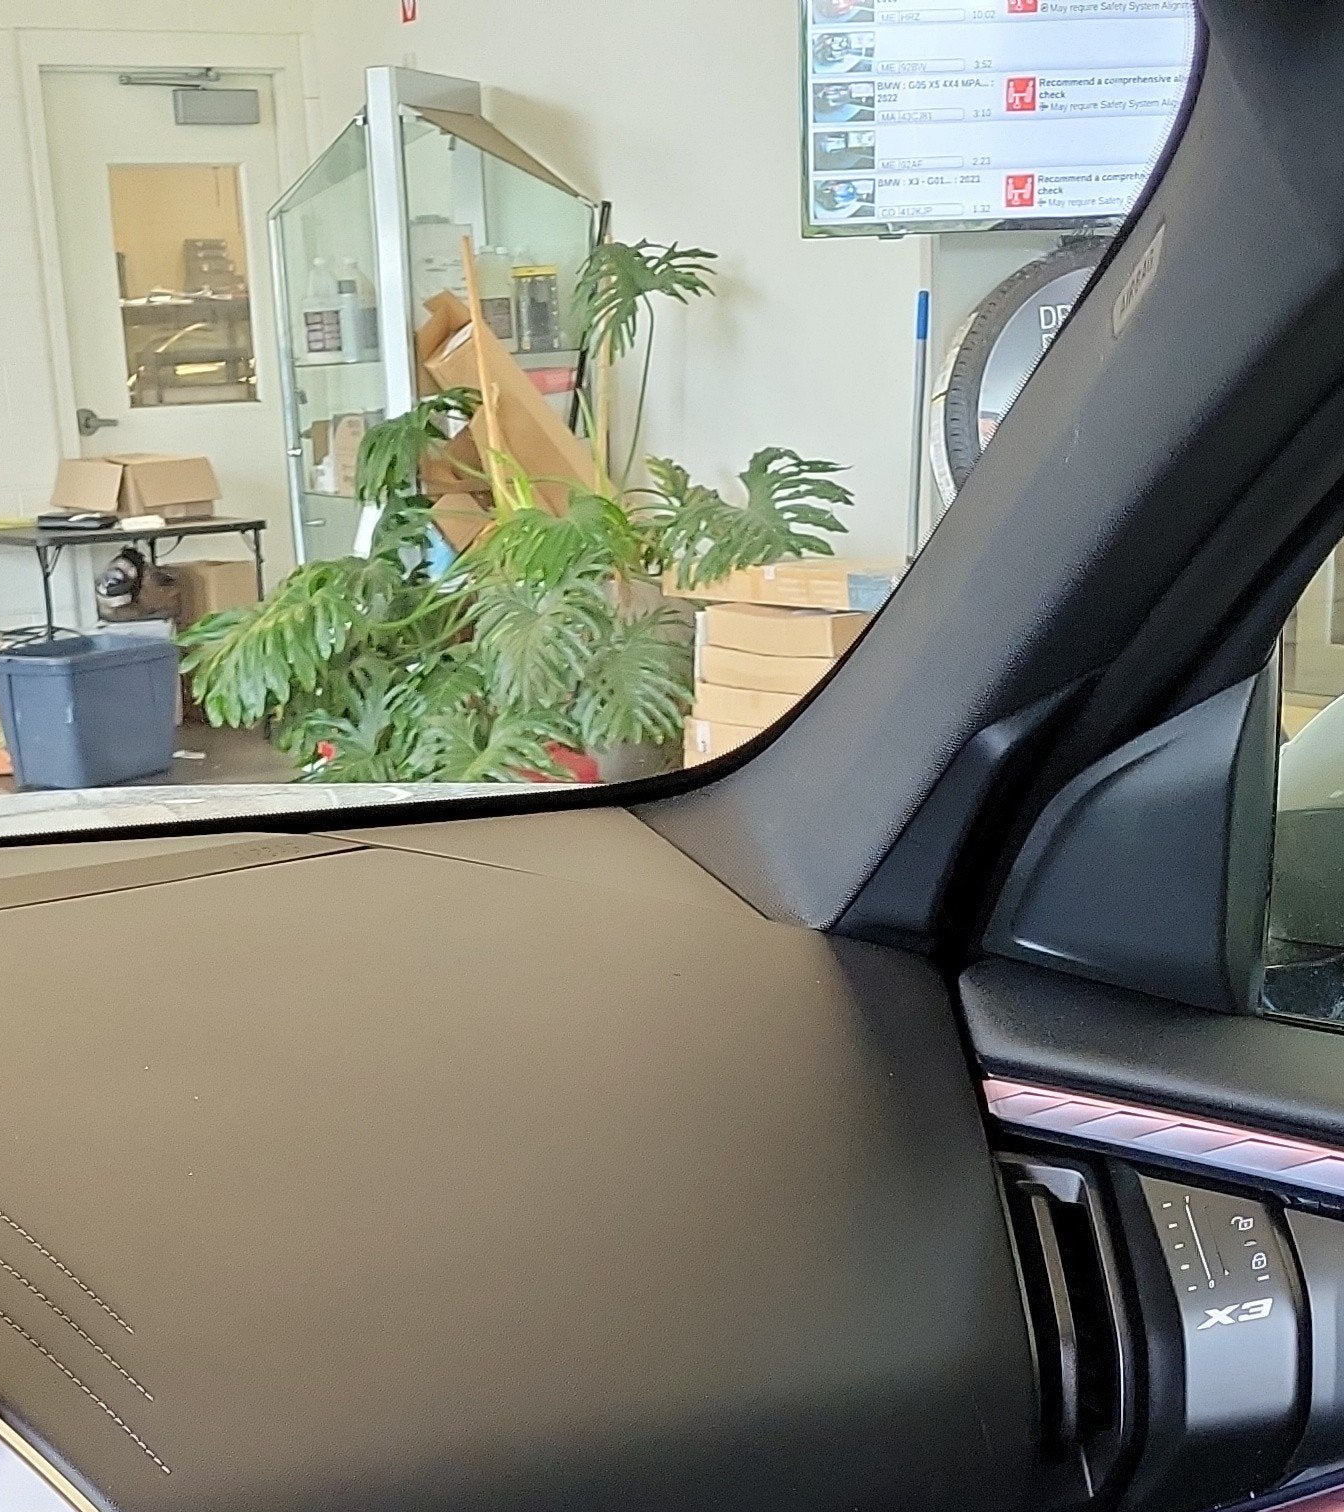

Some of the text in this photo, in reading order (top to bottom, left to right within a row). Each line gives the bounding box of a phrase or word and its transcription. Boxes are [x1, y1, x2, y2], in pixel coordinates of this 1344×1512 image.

[1070, 4, 1098, 12] require
[1101, 2, 1128, 11] Safety
[1129, 1, 1159, 10] System
[877, 81, 901, 91] BMW
[1039, 77, 1095, 88] Recommend
[1104, 75, 1171, 86] comprehensive
[1039, 90, 1065, 99] check
[1050, 103, 1068, 113] May
[1070, 102, 1098, 111] require
[1100, 100, 1128, 110] Safety
[1129, 99, 1159, 109] System
[877, 178, 901, 187] BMW
[1038, 174, 1092, 183] Recommend
[1038, 186, 1063, 195] check
[1197, 1297, 1273, 1330] X3
